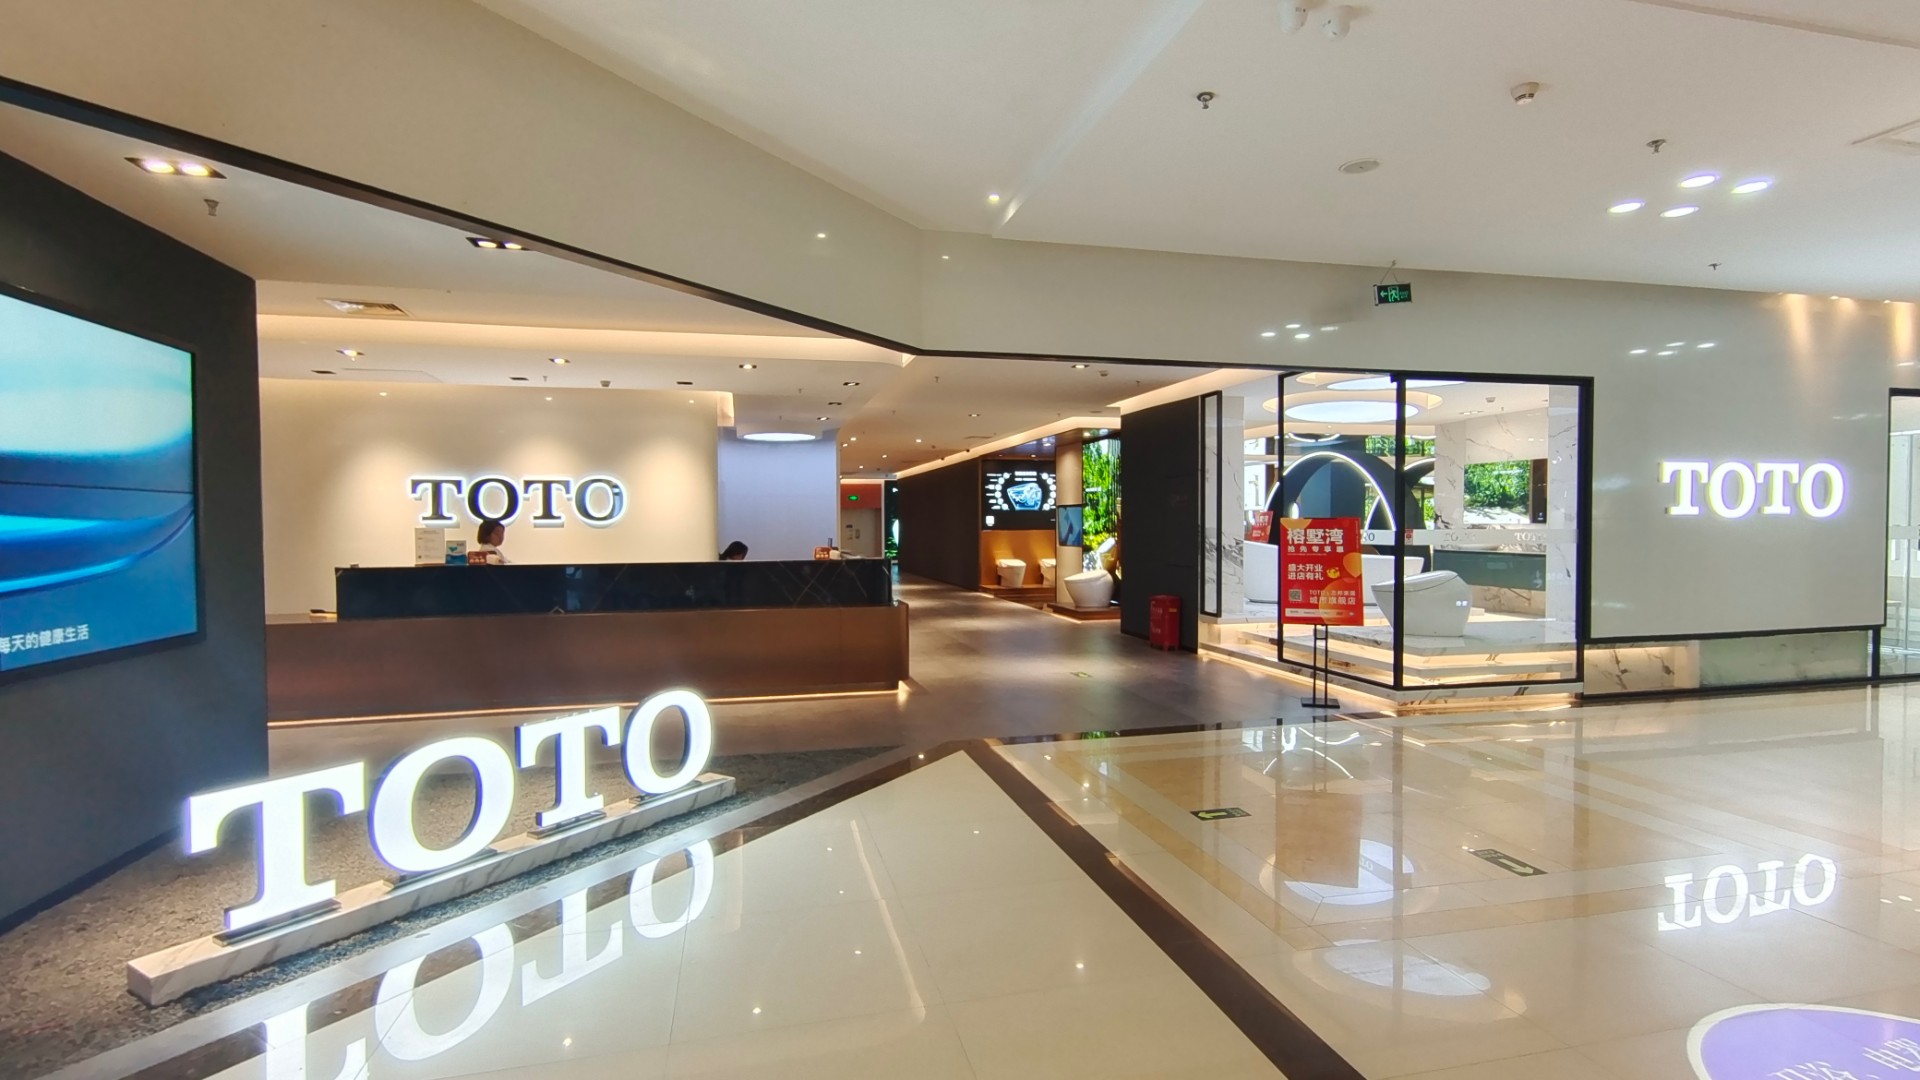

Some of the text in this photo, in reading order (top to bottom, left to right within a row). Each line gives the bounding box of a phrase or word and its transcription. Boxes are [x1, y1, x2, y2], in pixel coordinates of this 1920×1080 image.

[410, 473, 626, 527] TOTO
[1659, 460, 1846, 519] TOTO
[1287, 528, 1344, 545] 榕墅湾
[184, 688, 713, 931] TOTO
